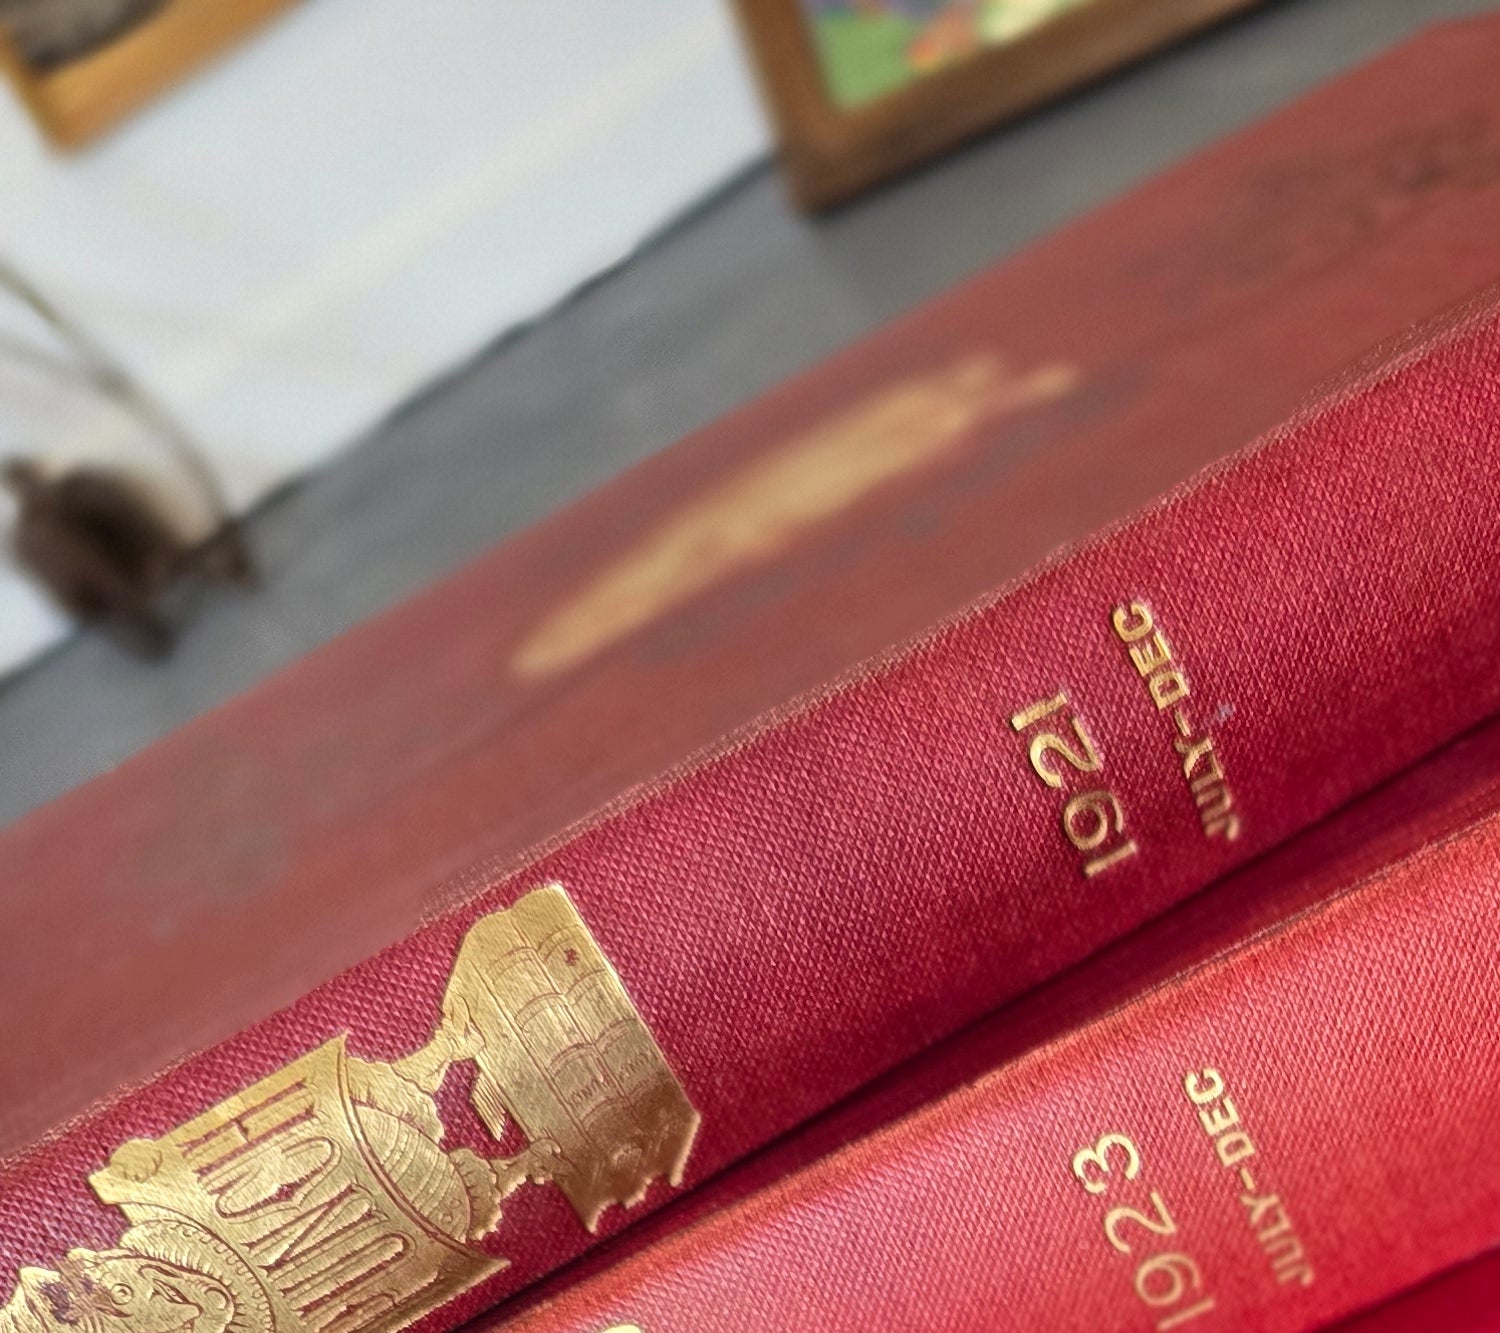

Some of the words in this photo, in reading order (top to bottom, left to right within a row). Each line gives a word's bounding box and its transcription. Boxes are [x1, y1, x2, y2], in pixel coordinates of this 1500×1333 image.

[1011, 692, 1138, 877] 1921
[1112, 602, 1240, 839] JULY-DEC
[1072, 1133, 1213, 1331] 1923
[1184, 1068, 1314, 1286] JULY-DEC
